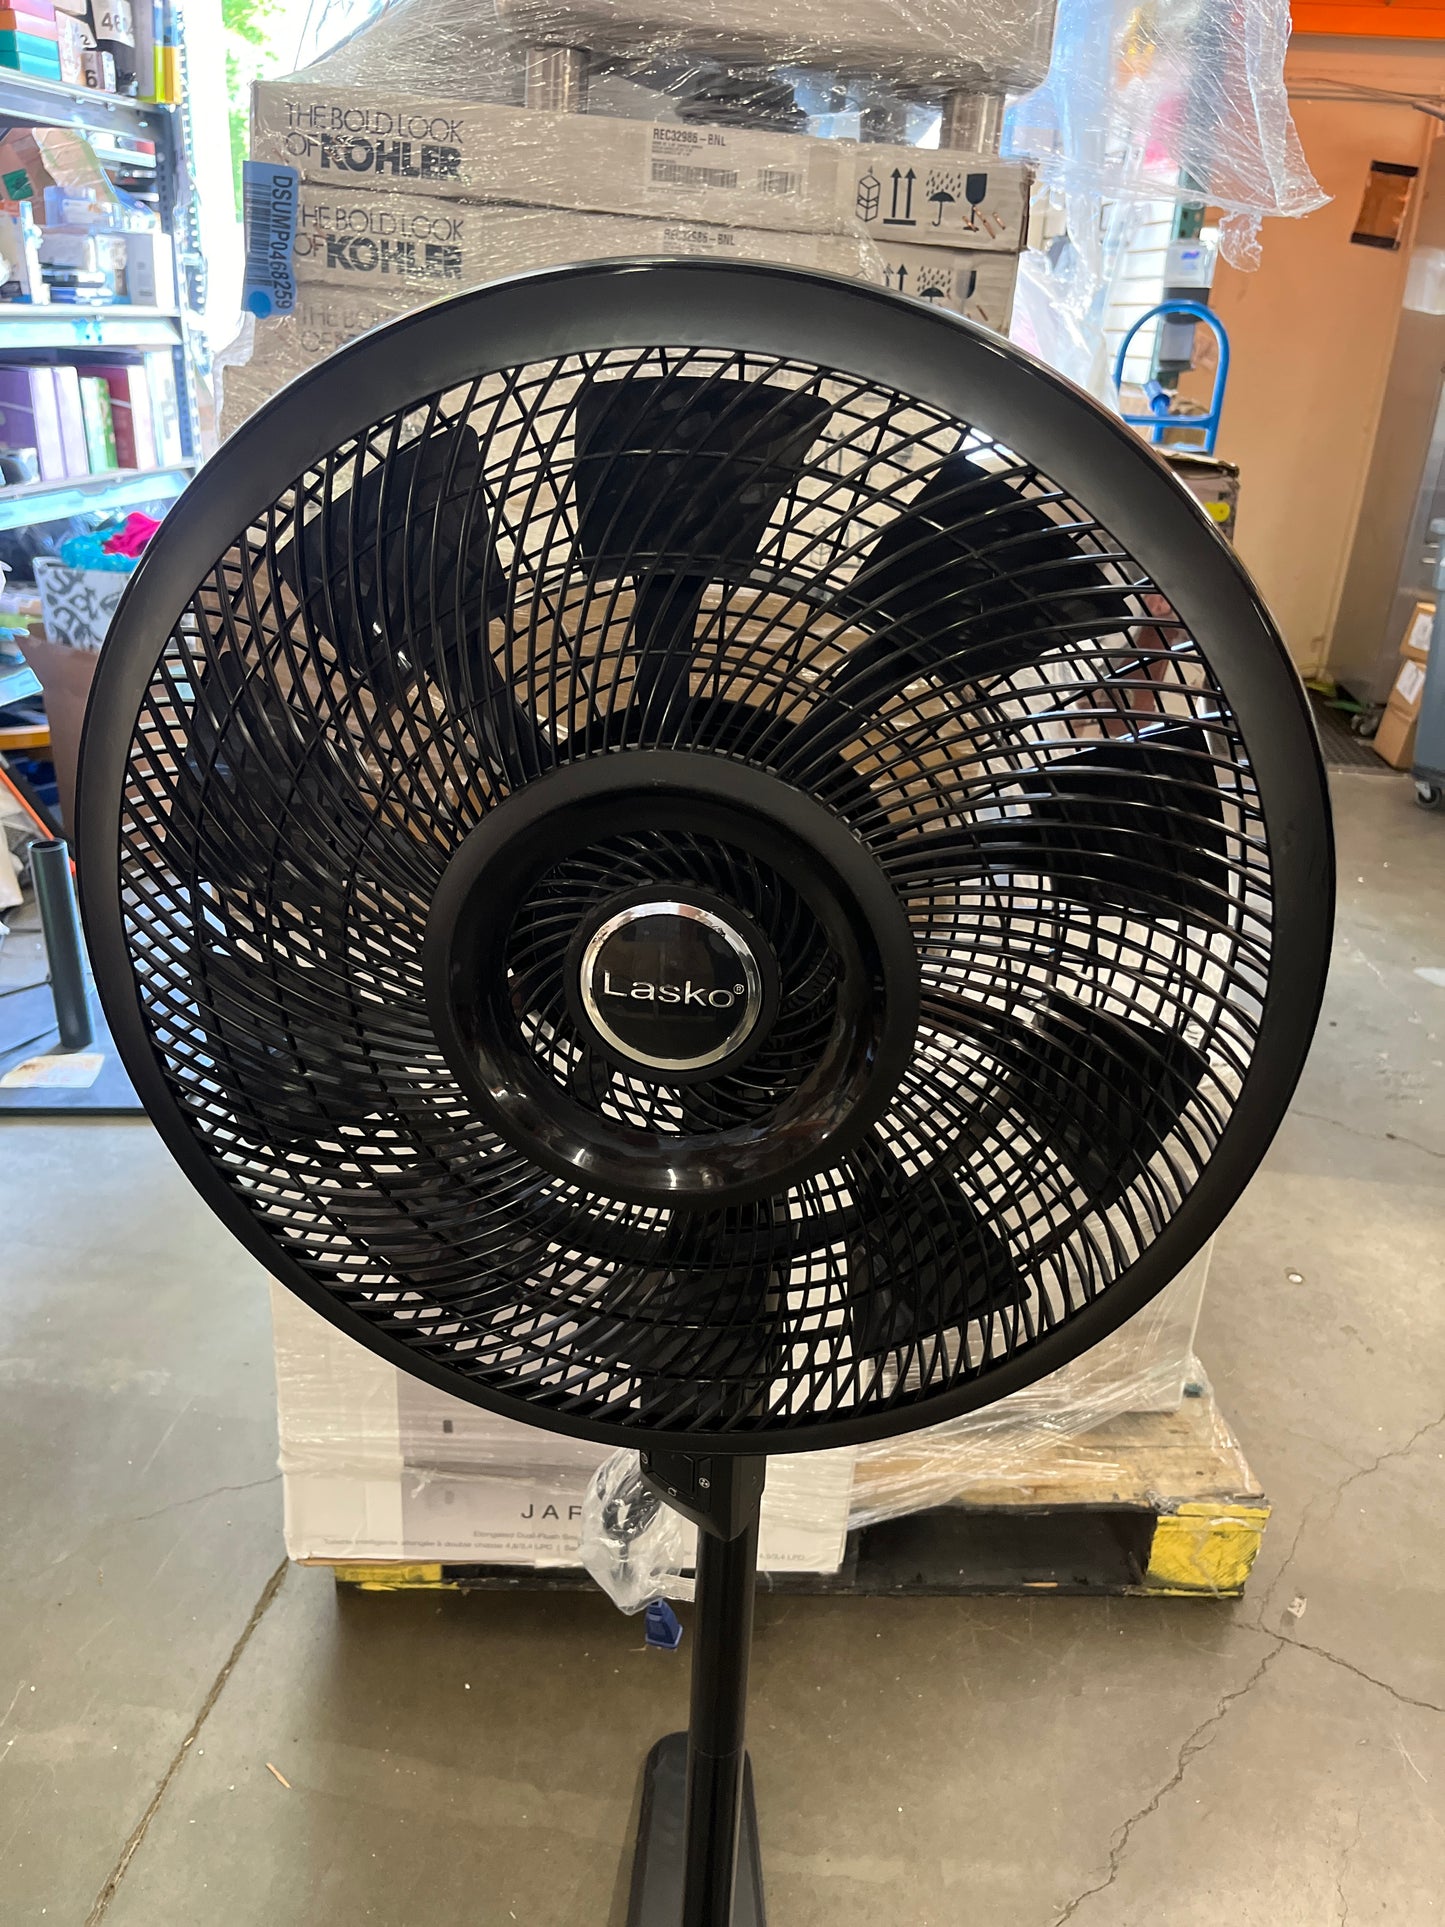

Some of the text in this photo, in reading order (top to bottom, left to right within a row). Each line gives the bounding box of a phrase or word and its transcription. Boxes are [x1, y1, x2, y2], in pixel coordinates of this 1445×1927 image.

[286, 102, 465, 144] THE BOLD LOOK
[285, 131, 463, 182] OF KOHLER
[268, 175, 293, 310] DSUMP0468259
[335, 209, 396, 236] BOLD
[401, 214, 465, 242] LOOK
[293, 232, 463, 280] OF KOHLER
